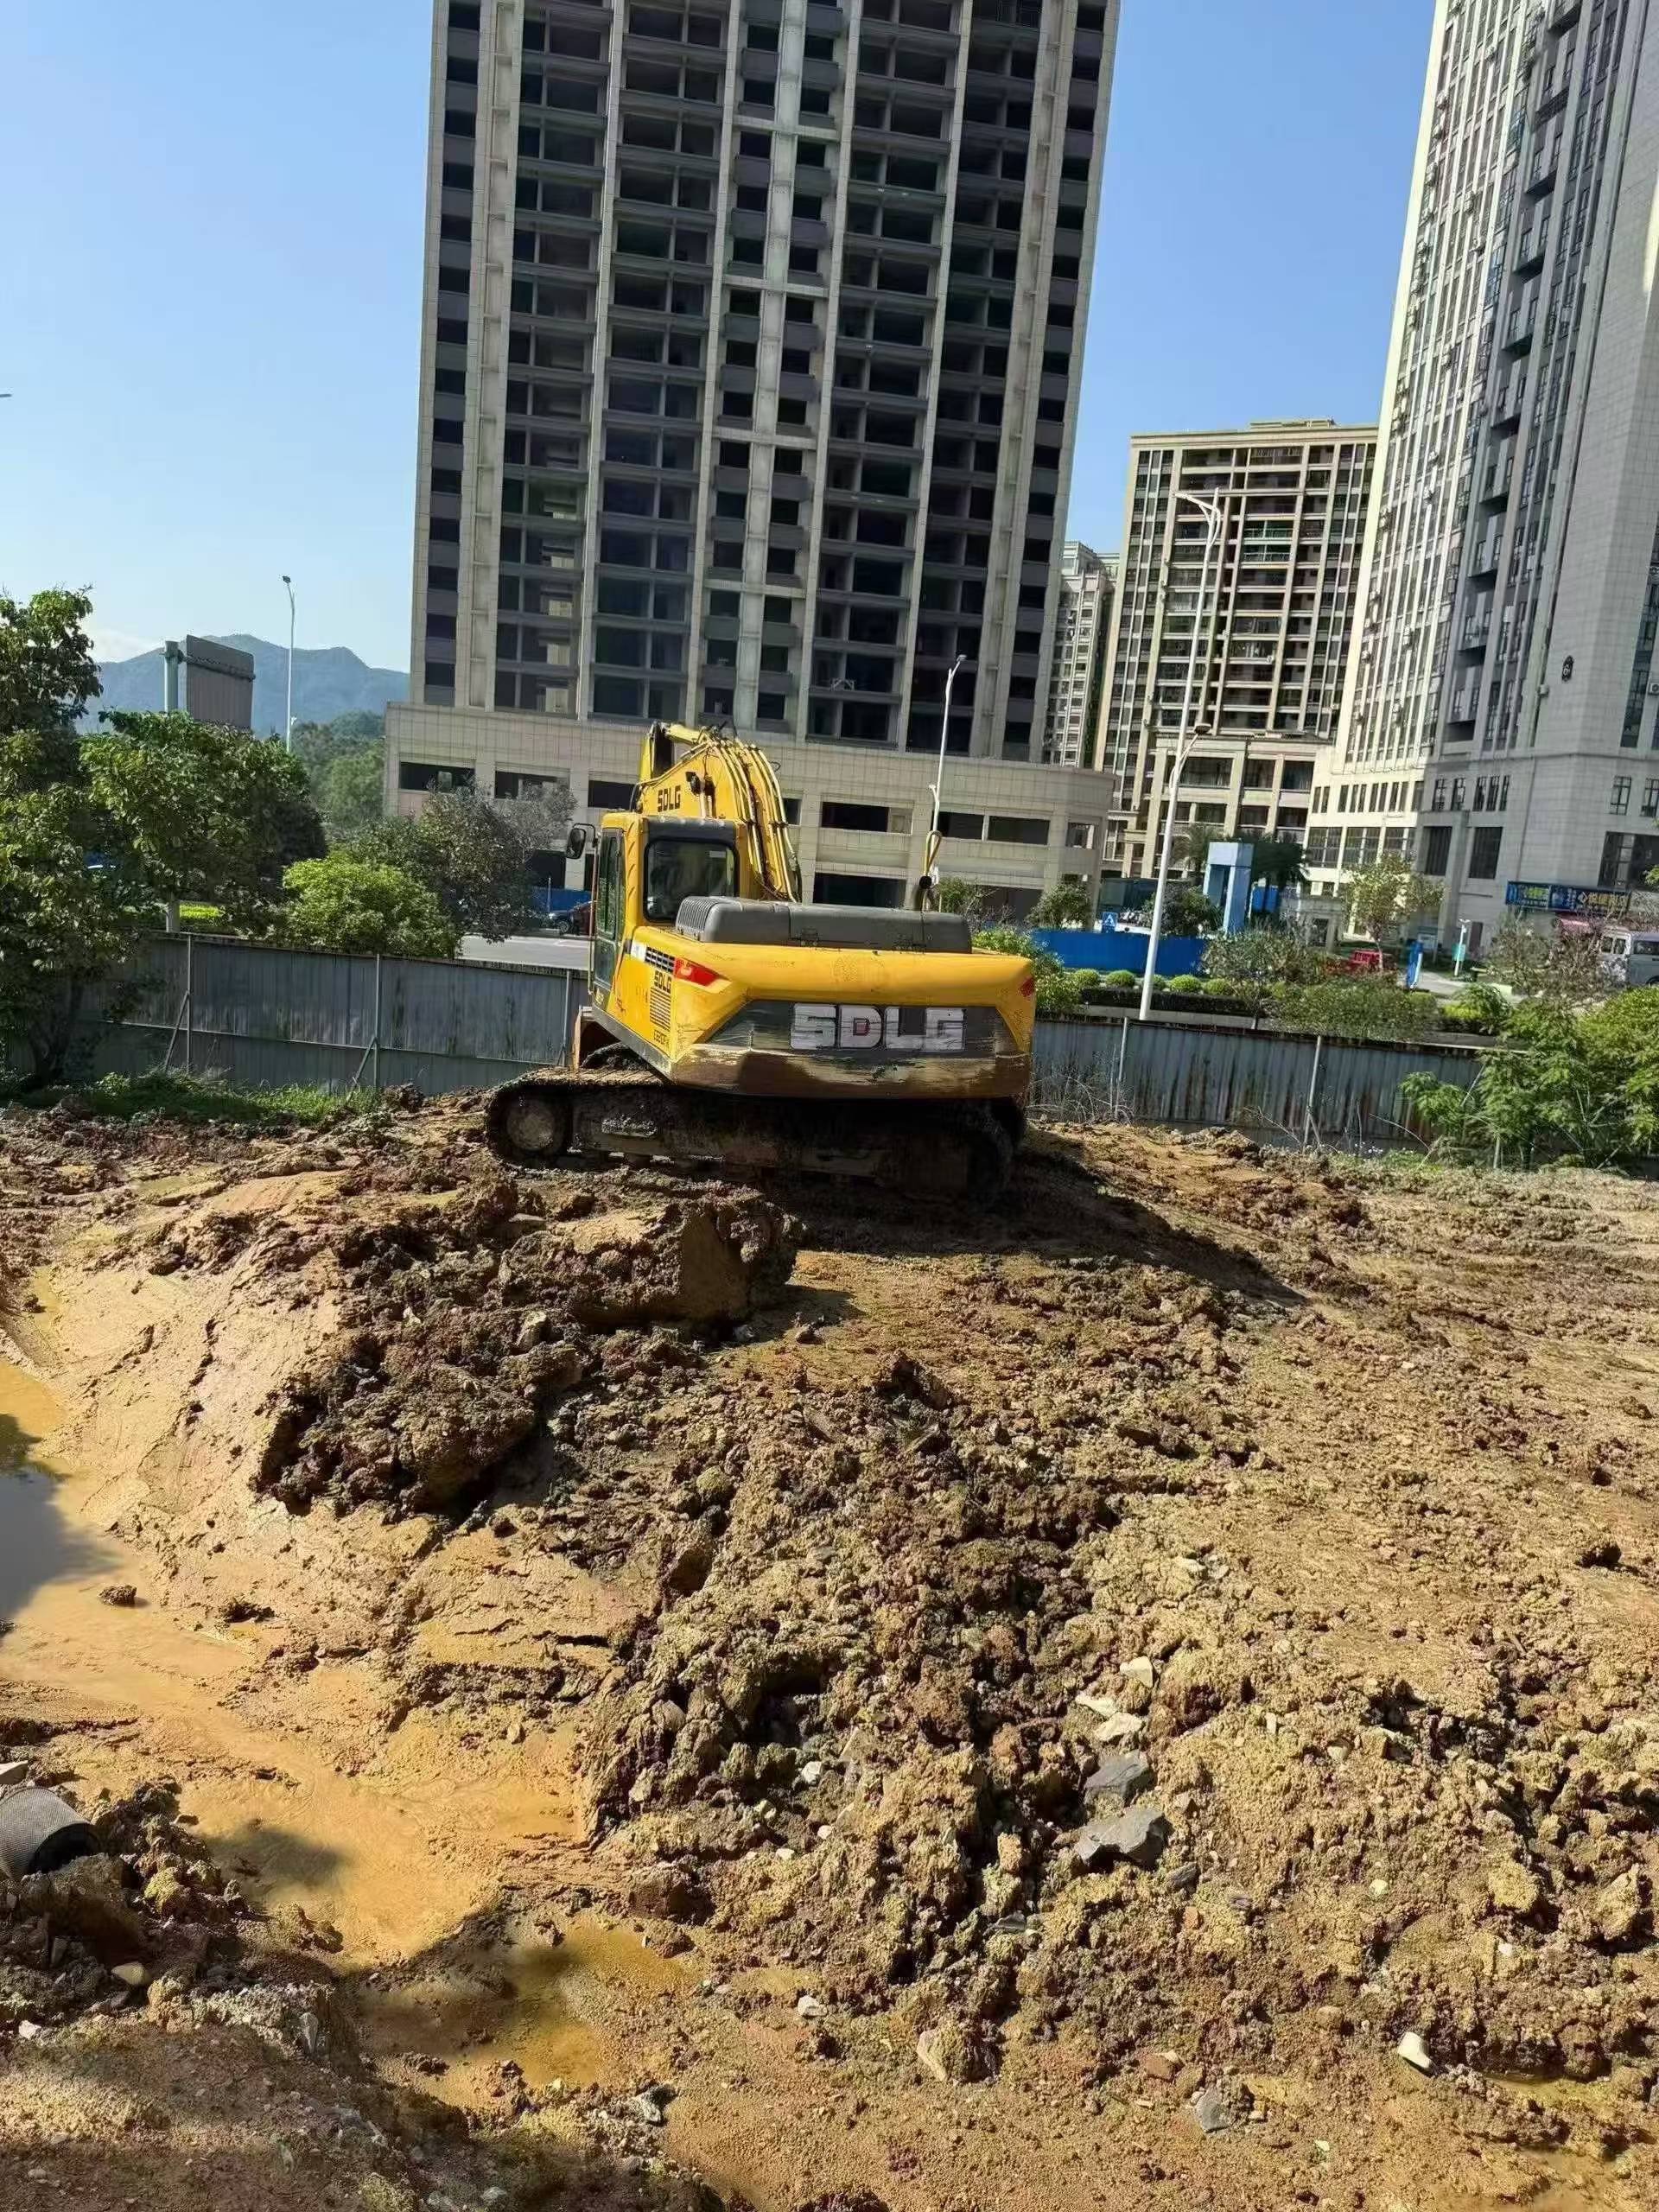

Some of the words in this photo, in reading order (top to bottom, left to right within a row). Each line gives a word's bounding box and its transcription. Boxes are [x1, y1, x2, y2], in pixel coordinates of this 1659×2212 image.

[658, 785, 681, 812] SDLG
[654, 969, 672, 995] SDLG
[790, 1003, 965, 1051] SDLG
